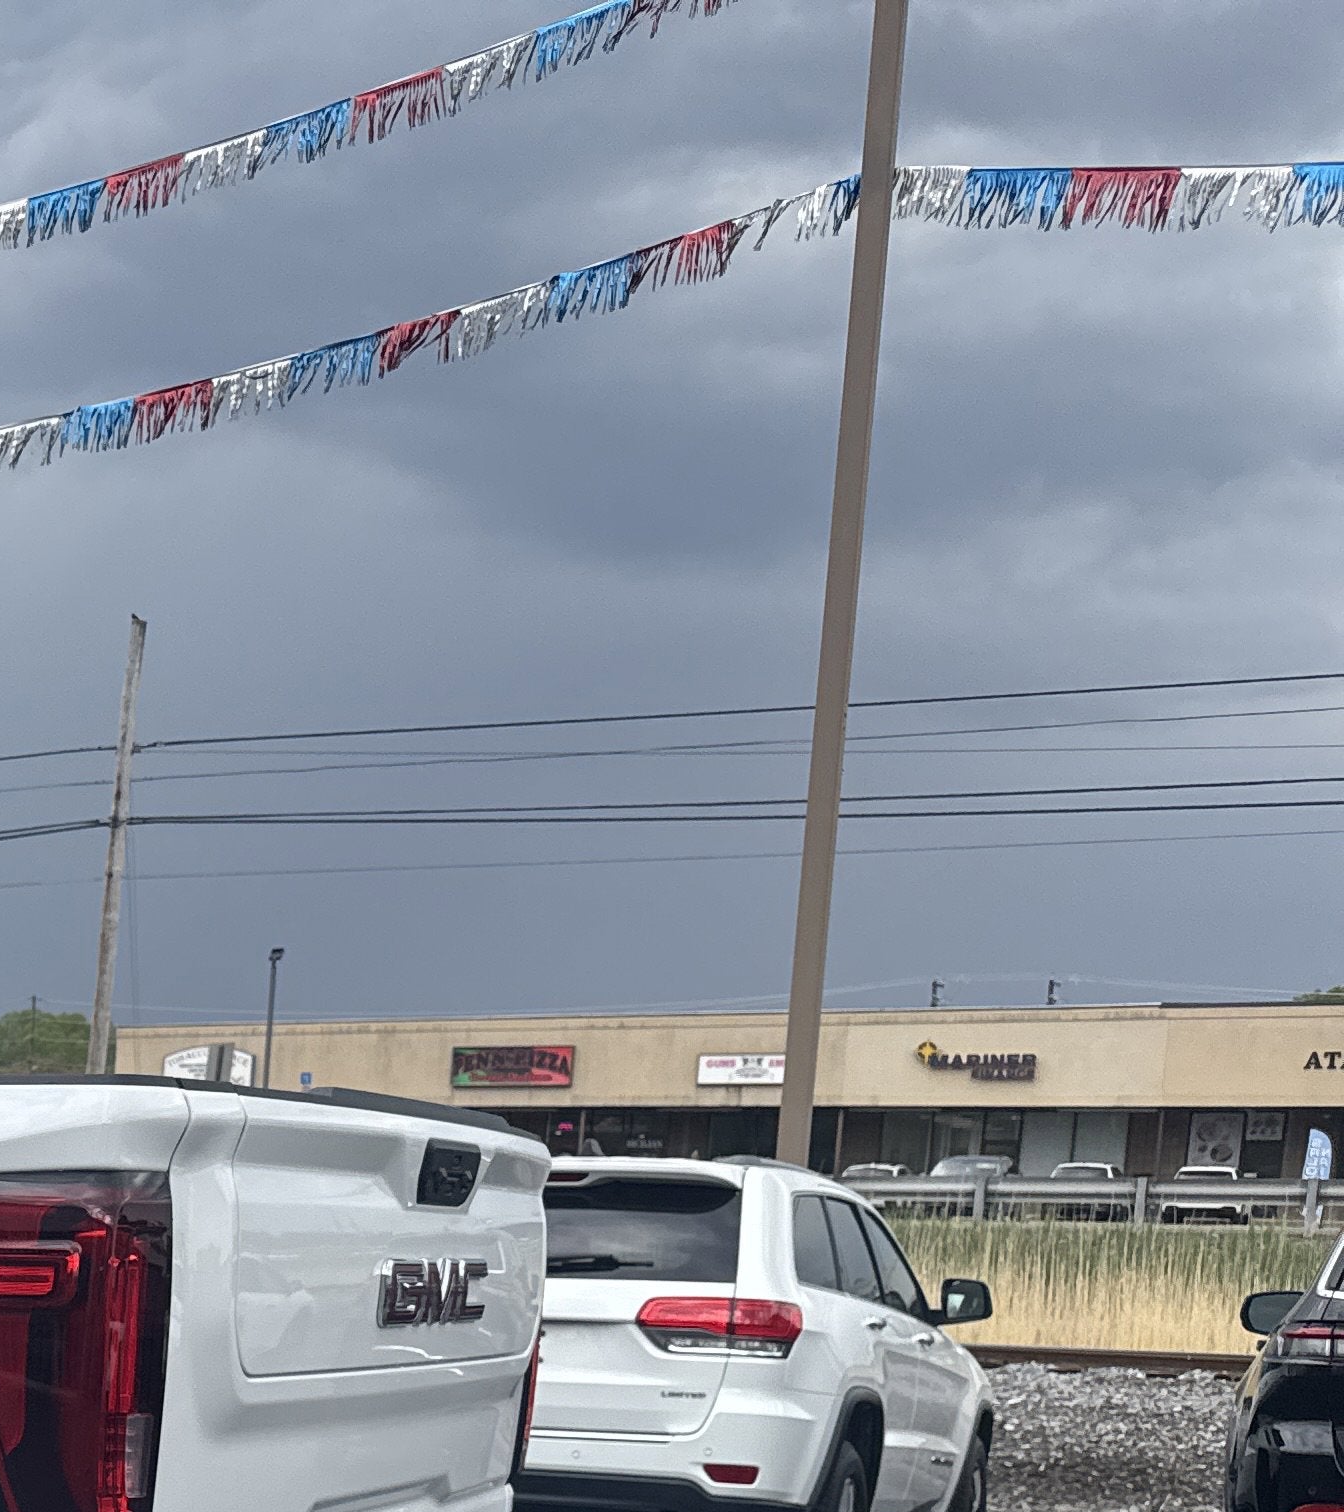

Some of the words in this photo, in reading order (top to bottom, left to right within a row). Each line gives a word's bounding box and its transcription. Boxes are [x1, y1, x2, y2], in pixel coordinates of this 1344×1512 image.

[514, 1050, 571, 1075] PIZZA
[928, 1053, 1037, 1071] MARINER
[1303, 1051, 1344, 1070] AT
[376, 1258, 488, 1329] GMC
[660, 1389, 706, 1399] LIMITED
